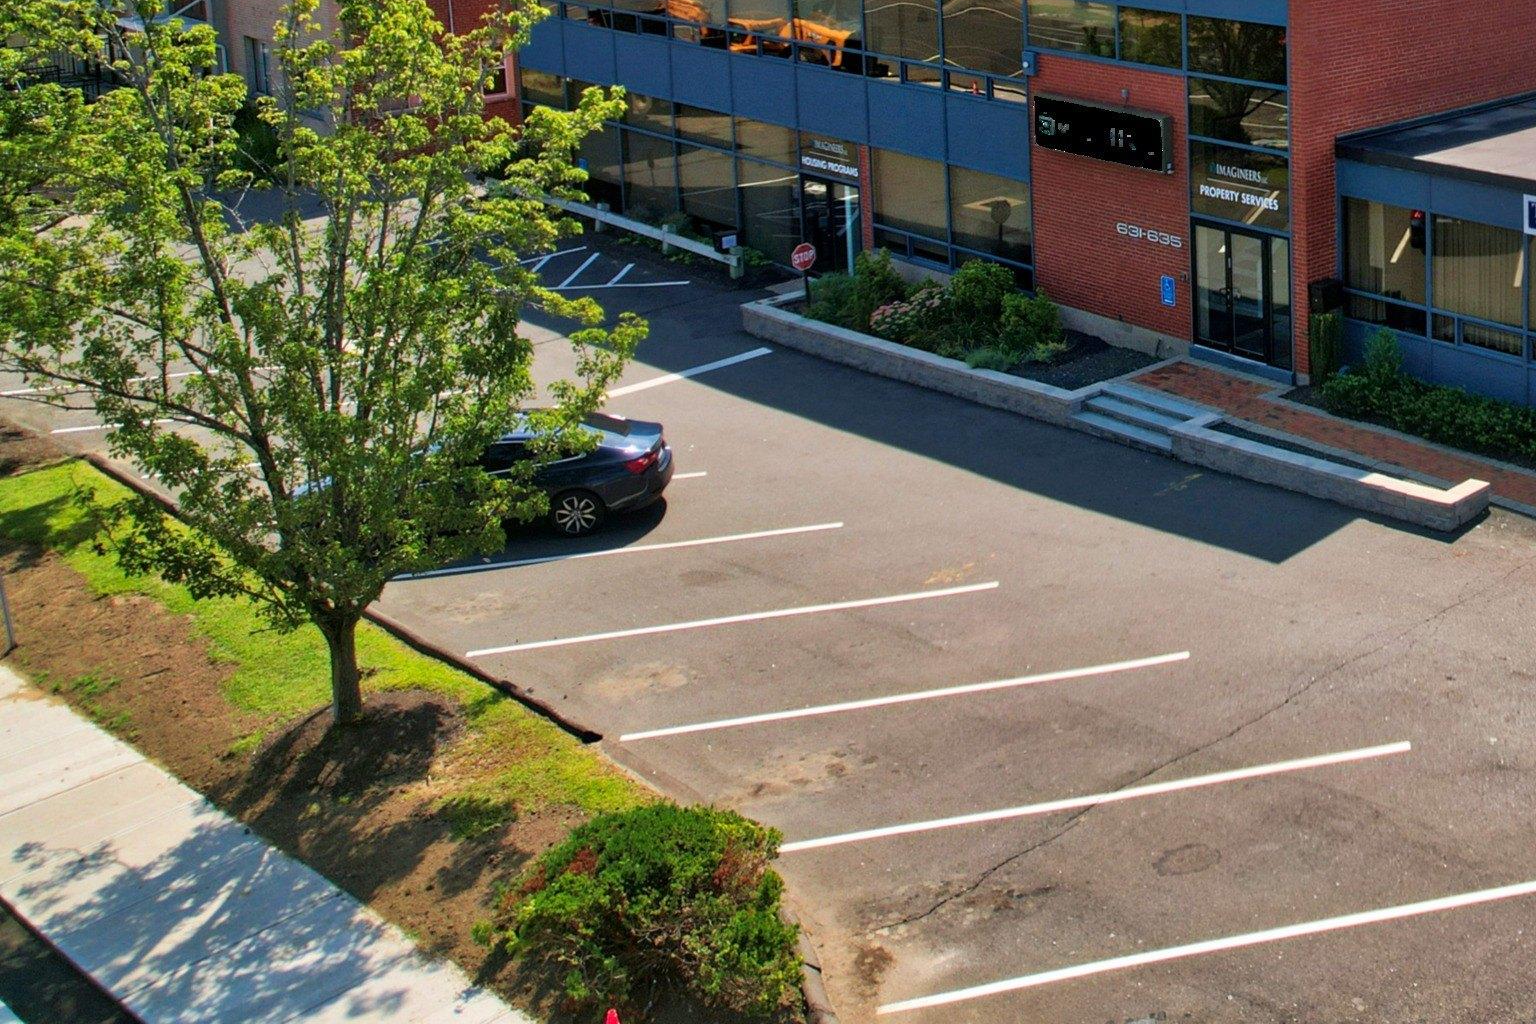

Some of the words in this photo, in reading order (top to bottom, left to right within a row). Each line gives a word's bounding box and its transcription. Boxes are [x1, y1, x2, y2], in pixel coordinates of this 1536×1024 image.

[801, 156, 827, 169] HOUSING
[828, 162, 858, 177] PROGRAMS
[1216, 164, 1261, 182] IMAGINEERS
[1200, 185, 1239, 202] PROPERTY
[1241, 193, 1279, 211] SERVICES
[1116, 223, 1182, 248] 631-635
[793, 249, 814, 264] STOP
